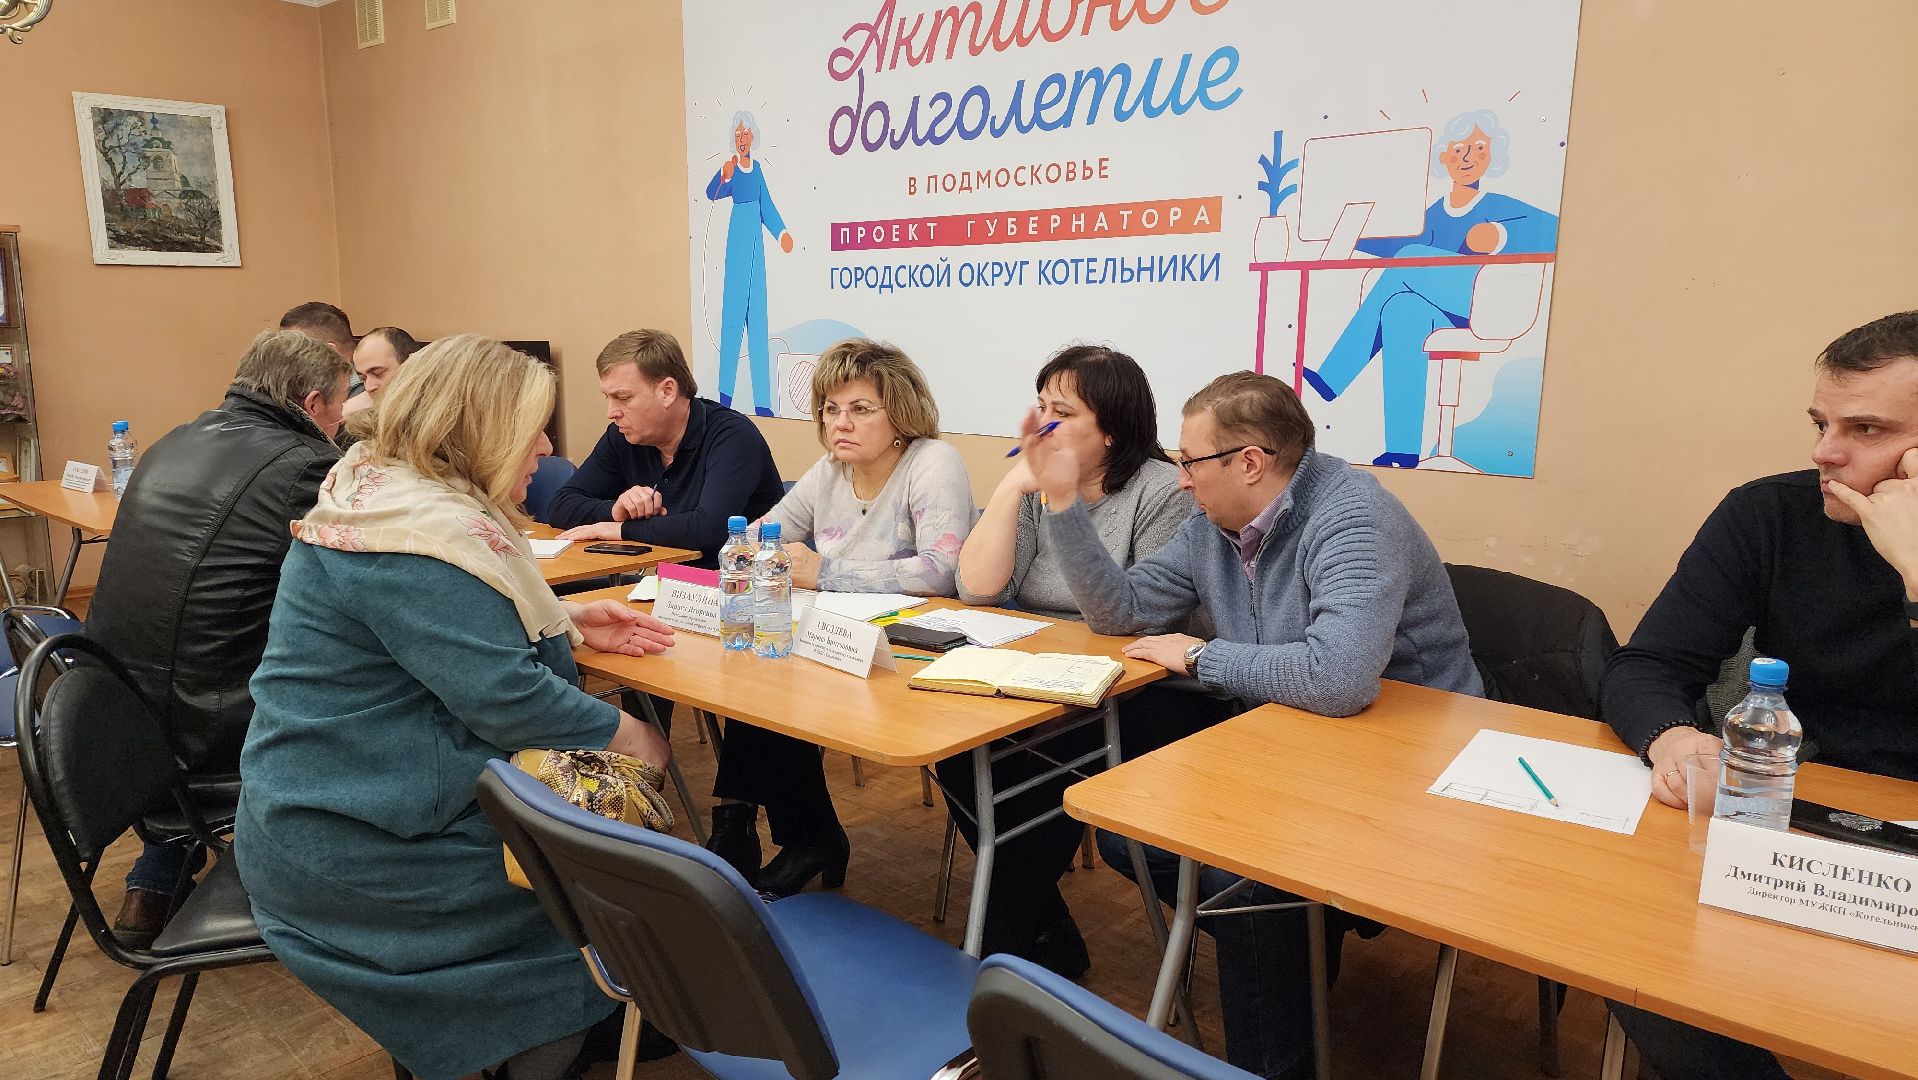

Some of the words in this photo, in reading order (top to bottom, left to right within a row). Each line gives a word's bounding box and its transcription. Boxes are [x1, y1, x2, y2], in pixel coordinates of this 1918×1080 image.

[828, 0, 1230, 81] Активн
[829, 45, 1243, 156] долголетие
[908, 177, 918, 197] В
[926, 158, 1110, 196] ПОДМОСКОВЬЕ
[840, 221, 937, 245] ПРОЕКТ
[967, 204, 1212, 239] ГУБЕРНАТОРА
[830, 256, 951, 295] ГОРОДСКОЙ
[959, 259, 1030, 289] ОКРУГ
[1038, 252, 1221, 287] КОТЕЛЬНИКИ
[1725, 864, 1807, 893] Дмитрий
[1770, 851, 1912, 893] КИСЛЕНКО
[1747, 886, 1796, 905] Директор
[1798, 896, 1847, 916] МУЖКП
